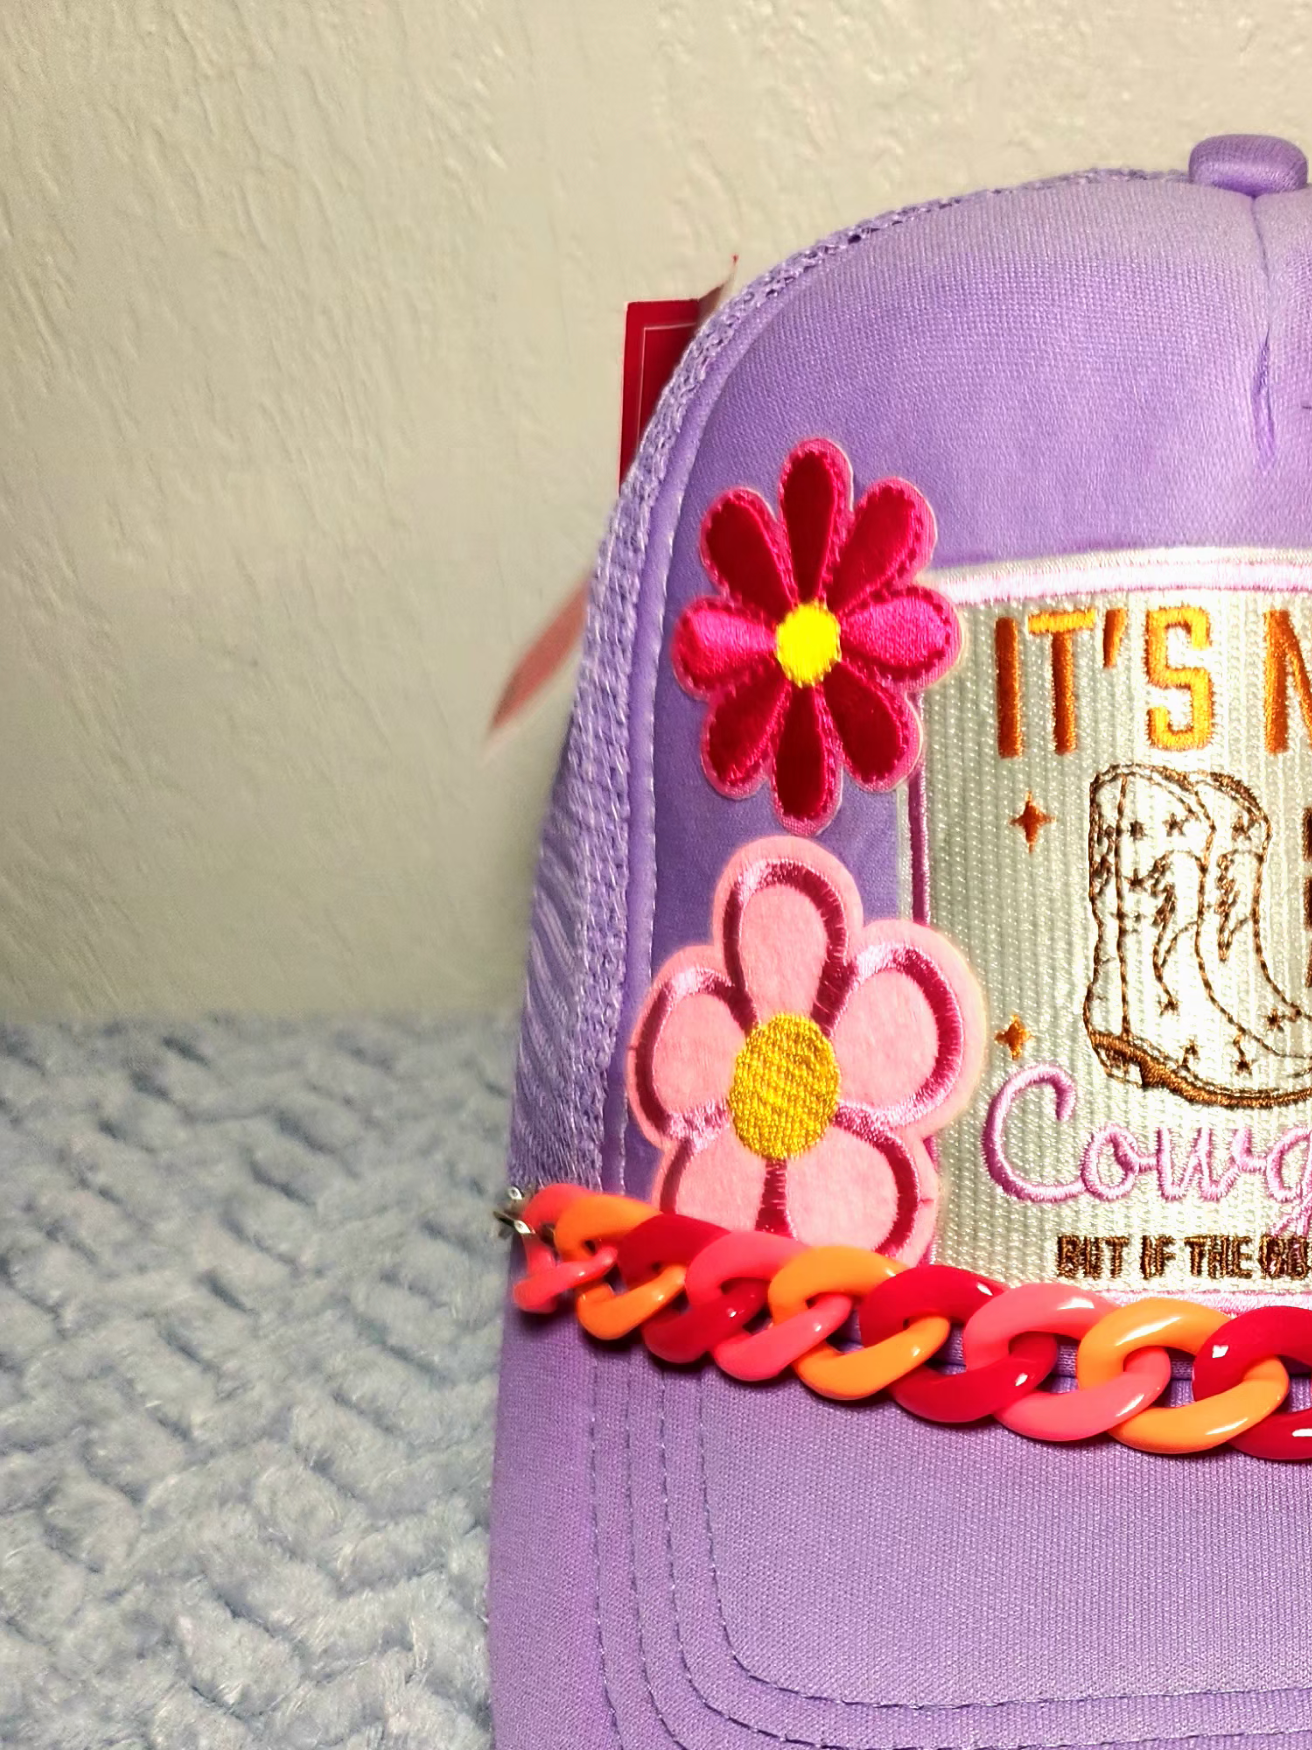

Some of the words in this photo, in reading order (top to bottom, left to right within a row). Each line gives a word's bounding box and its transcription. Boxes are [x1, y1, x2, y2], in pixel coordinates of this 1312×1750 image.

[996, 604, 1216, 758] IT'S
[1057, 1235, 1128, 1277] BUT
[1139, 1235, 1172, 1279] IF
[1183, 1235, 1253, 1279] THE
